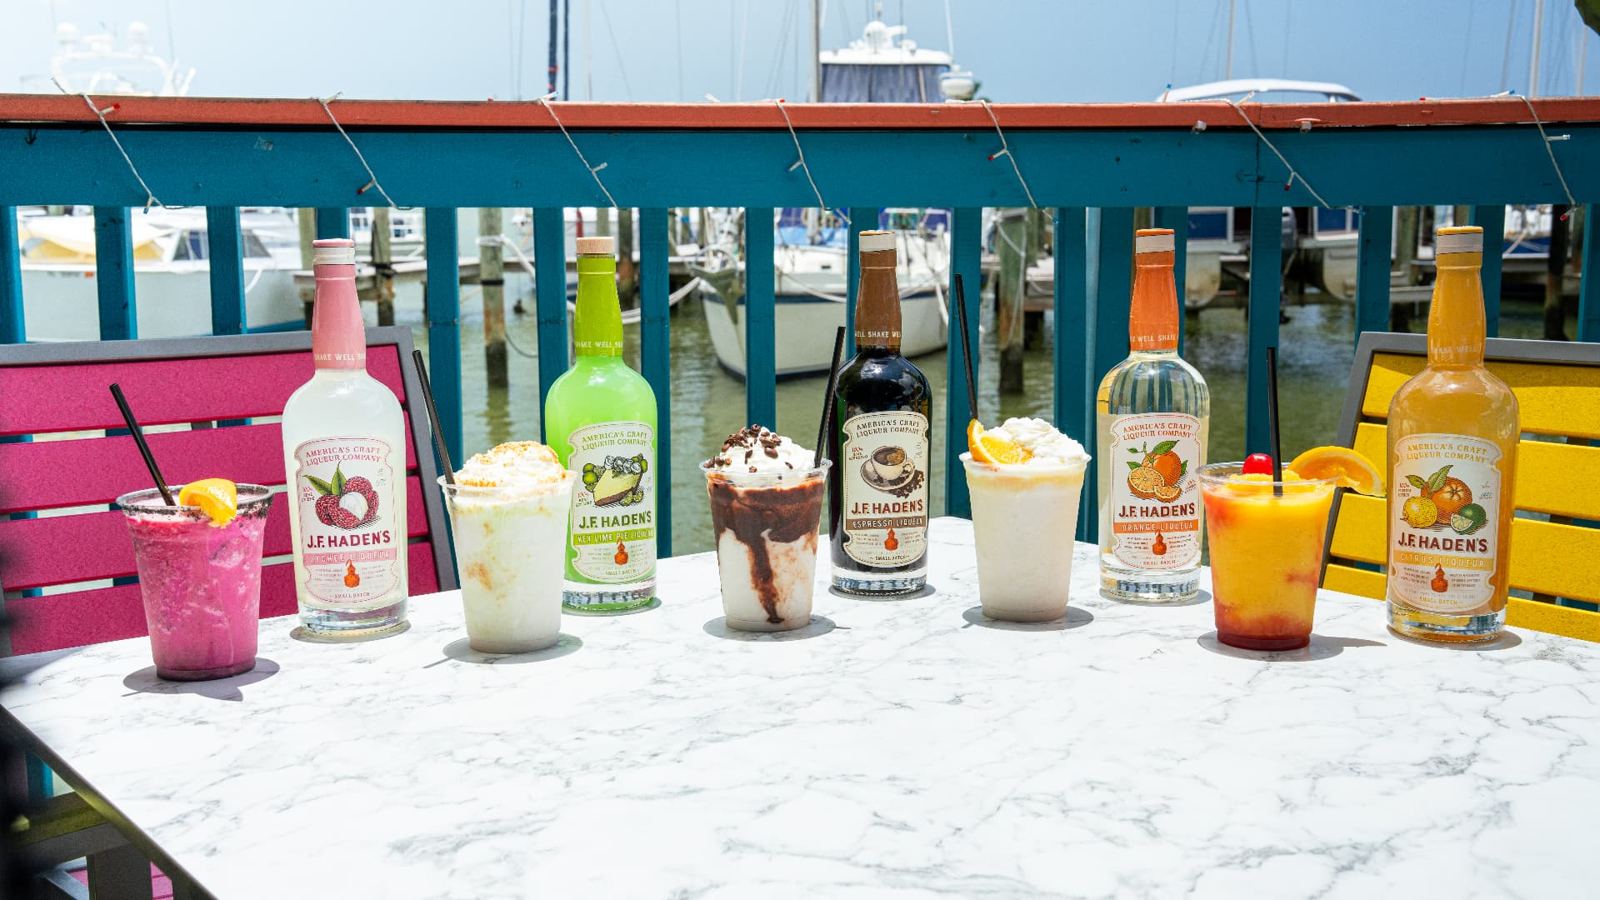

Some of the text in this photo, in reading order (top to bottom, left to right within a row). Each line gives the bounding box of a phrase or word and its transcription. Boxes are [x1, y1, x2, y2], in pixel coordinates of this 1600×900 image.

[856, 420, 896, 430] AMERICA'S
[1123, 423, 1165, 432] AMERICA'S
[856, 427, 888, 438] LIQUEUR
[1123, 430, 1191, 440] LIQUEUR COMPANY
[582, 438, 647, 451] LIQUEUR COMPANY
[306, 446, 350, 458] AMERICA'S
[1444, 452, 1486, 463] COMPANY
[306, 454, 380, 466] LIQUEUR COMPANY
[852, 499, 923, 514] J.F. HADEN'S
[1119, 503, 1195, 517] J.F. HADEN'S
[579, 510, 652, 528] J.F. HADEN'S
[307, 530, 391, 548] J.F. HADEN'S
[1398, 532, 1488, 552] J.F. HADEN'S
